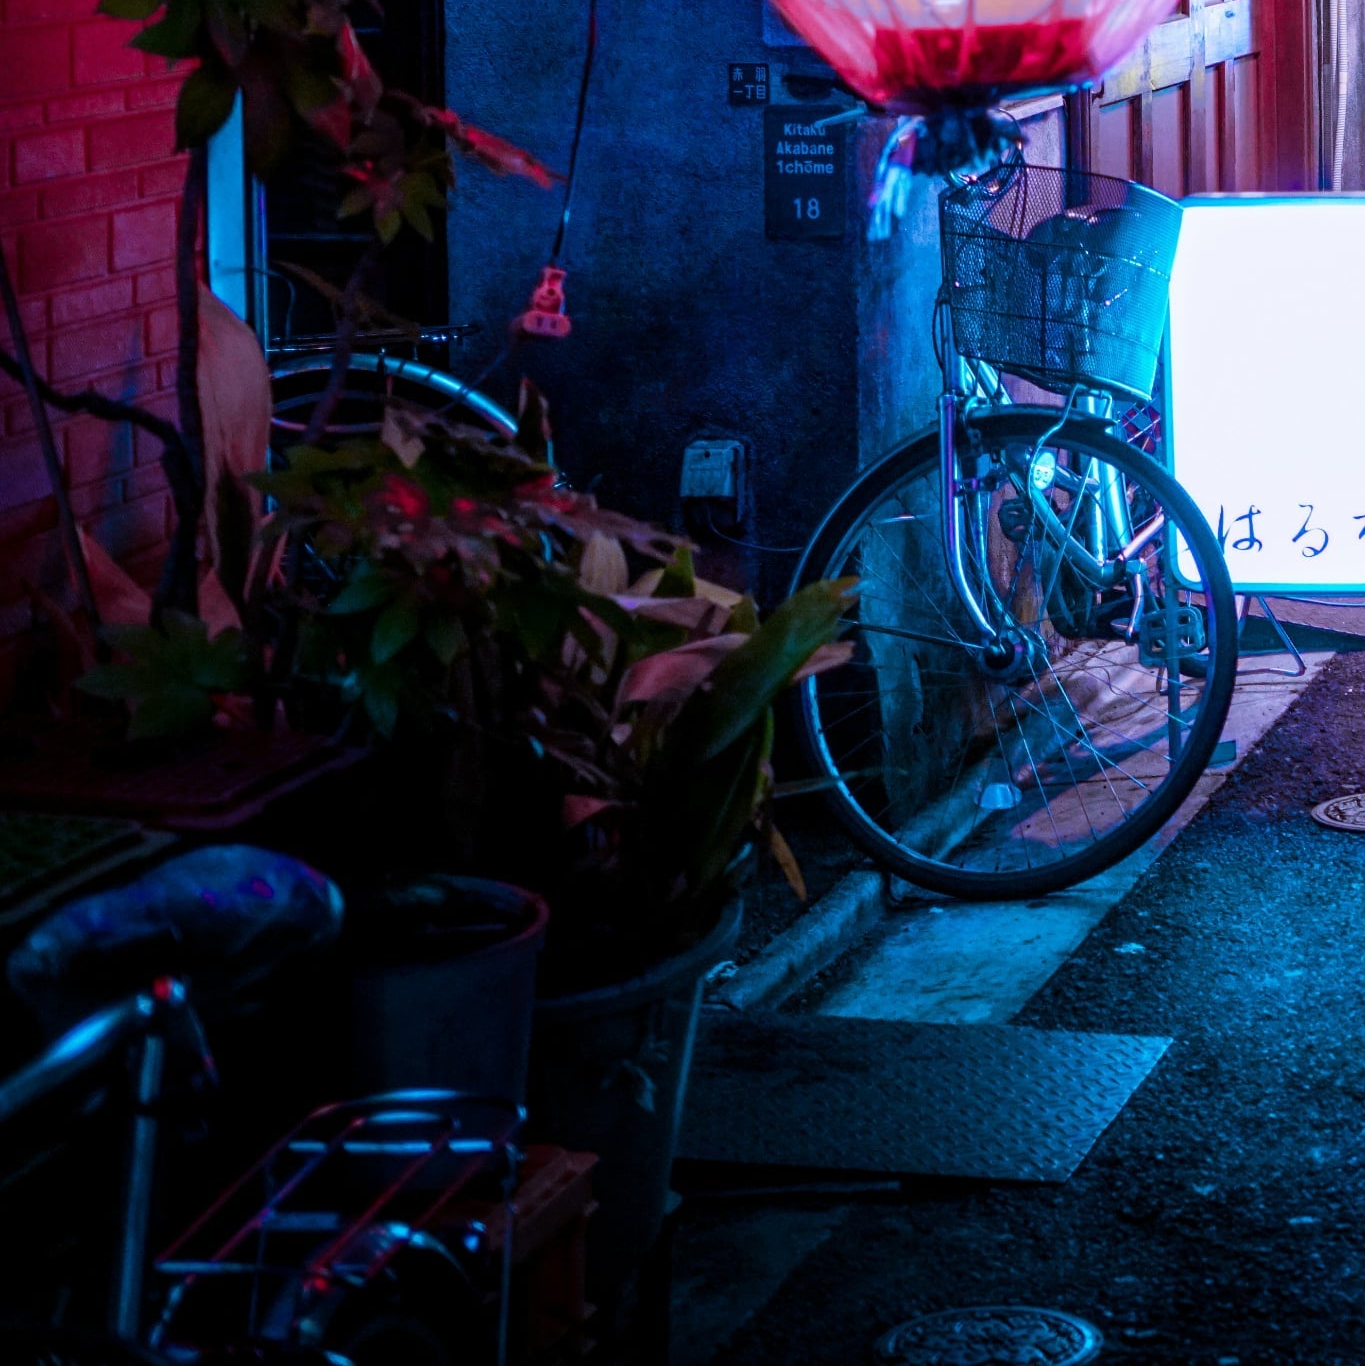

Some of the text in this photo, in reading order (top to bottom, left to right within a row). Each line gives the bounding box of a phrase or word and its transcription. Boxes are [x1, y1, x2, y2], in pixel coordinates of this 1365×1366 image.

[732, 85, 767, 100] 一丁目
[783, 122, 827, 137] Kitaku
[775, 141, 835, 155] Akabane
[776, 160, 835, 175] 1chōme
[793, 197, 821, 220] 18
